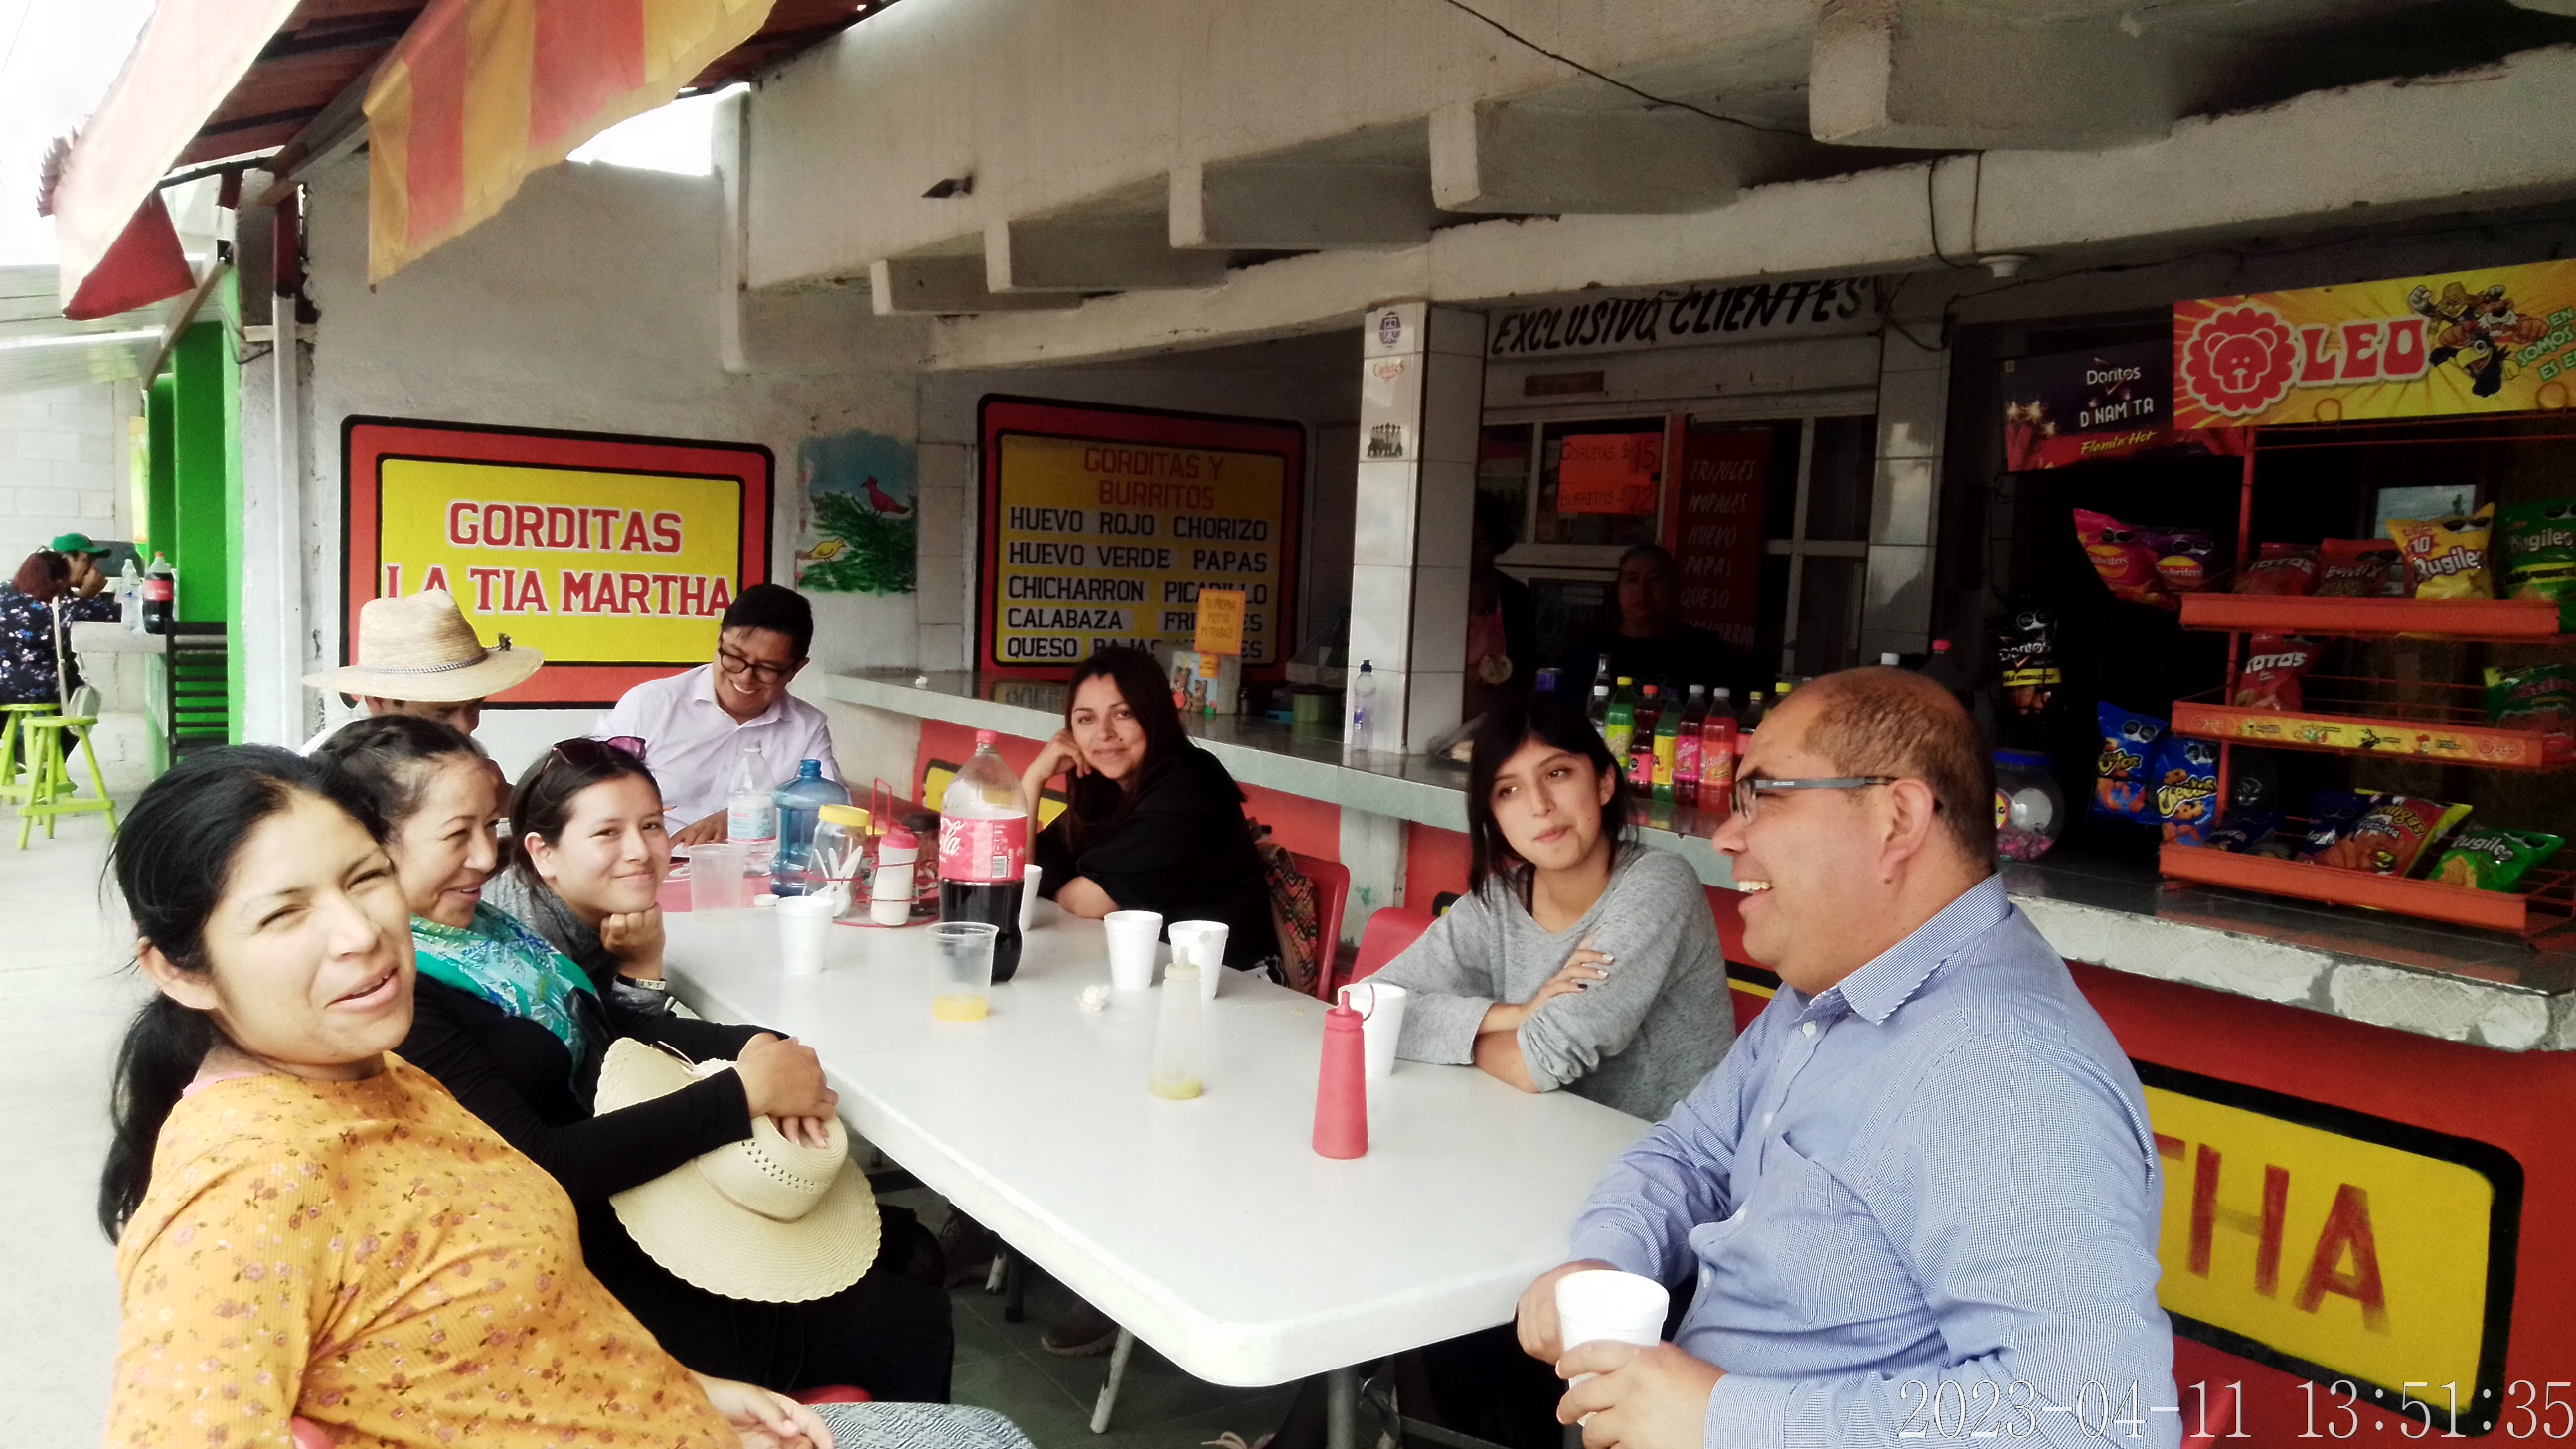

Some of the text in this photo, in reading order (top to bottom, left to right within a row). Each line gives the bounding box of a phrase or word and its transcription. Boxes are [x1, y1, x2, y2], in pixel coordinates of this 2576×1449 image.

[2298, 319, 2427, 384] LEO
[2516, 326, 2574, 368] SOMOS
[2087, 366, 2141, 386] Doritos
[2128, 430, 2158, 445] Hot
[1561, 442, 1615, 461] GORDITAS
[1083, 447, 1226, 481] GORDITAS Y
[1691, 458, 1757, 482] FRIJOLES
[1098, 480, 1215, 510] BURRITOS
[1689, 492, 1748, 514] NOPALES
[448, 500, 684, 555] GORDITAS
[1009, 506, 1268, 541] HUEVO ROJO CHORIZO
[1689, 524, 1738, 548] HUEVO
[2410, 536, 2431, 553] 10
[1009, 542, 1267, 573] HUEVO VERDE PAPAS
[1685, 555, 1734, 578] PAPAS
[469, 566, 550, 612] TIA
[562, 569, 733, 617] MARTHA
[1008, 575, 1145, 602] CHICHARRON
[1680, 585, 1731, 610] QUESO
[1007, 608, 1123, 630] CALABAZA
[1007, 637, 1078, 659] QUESO
